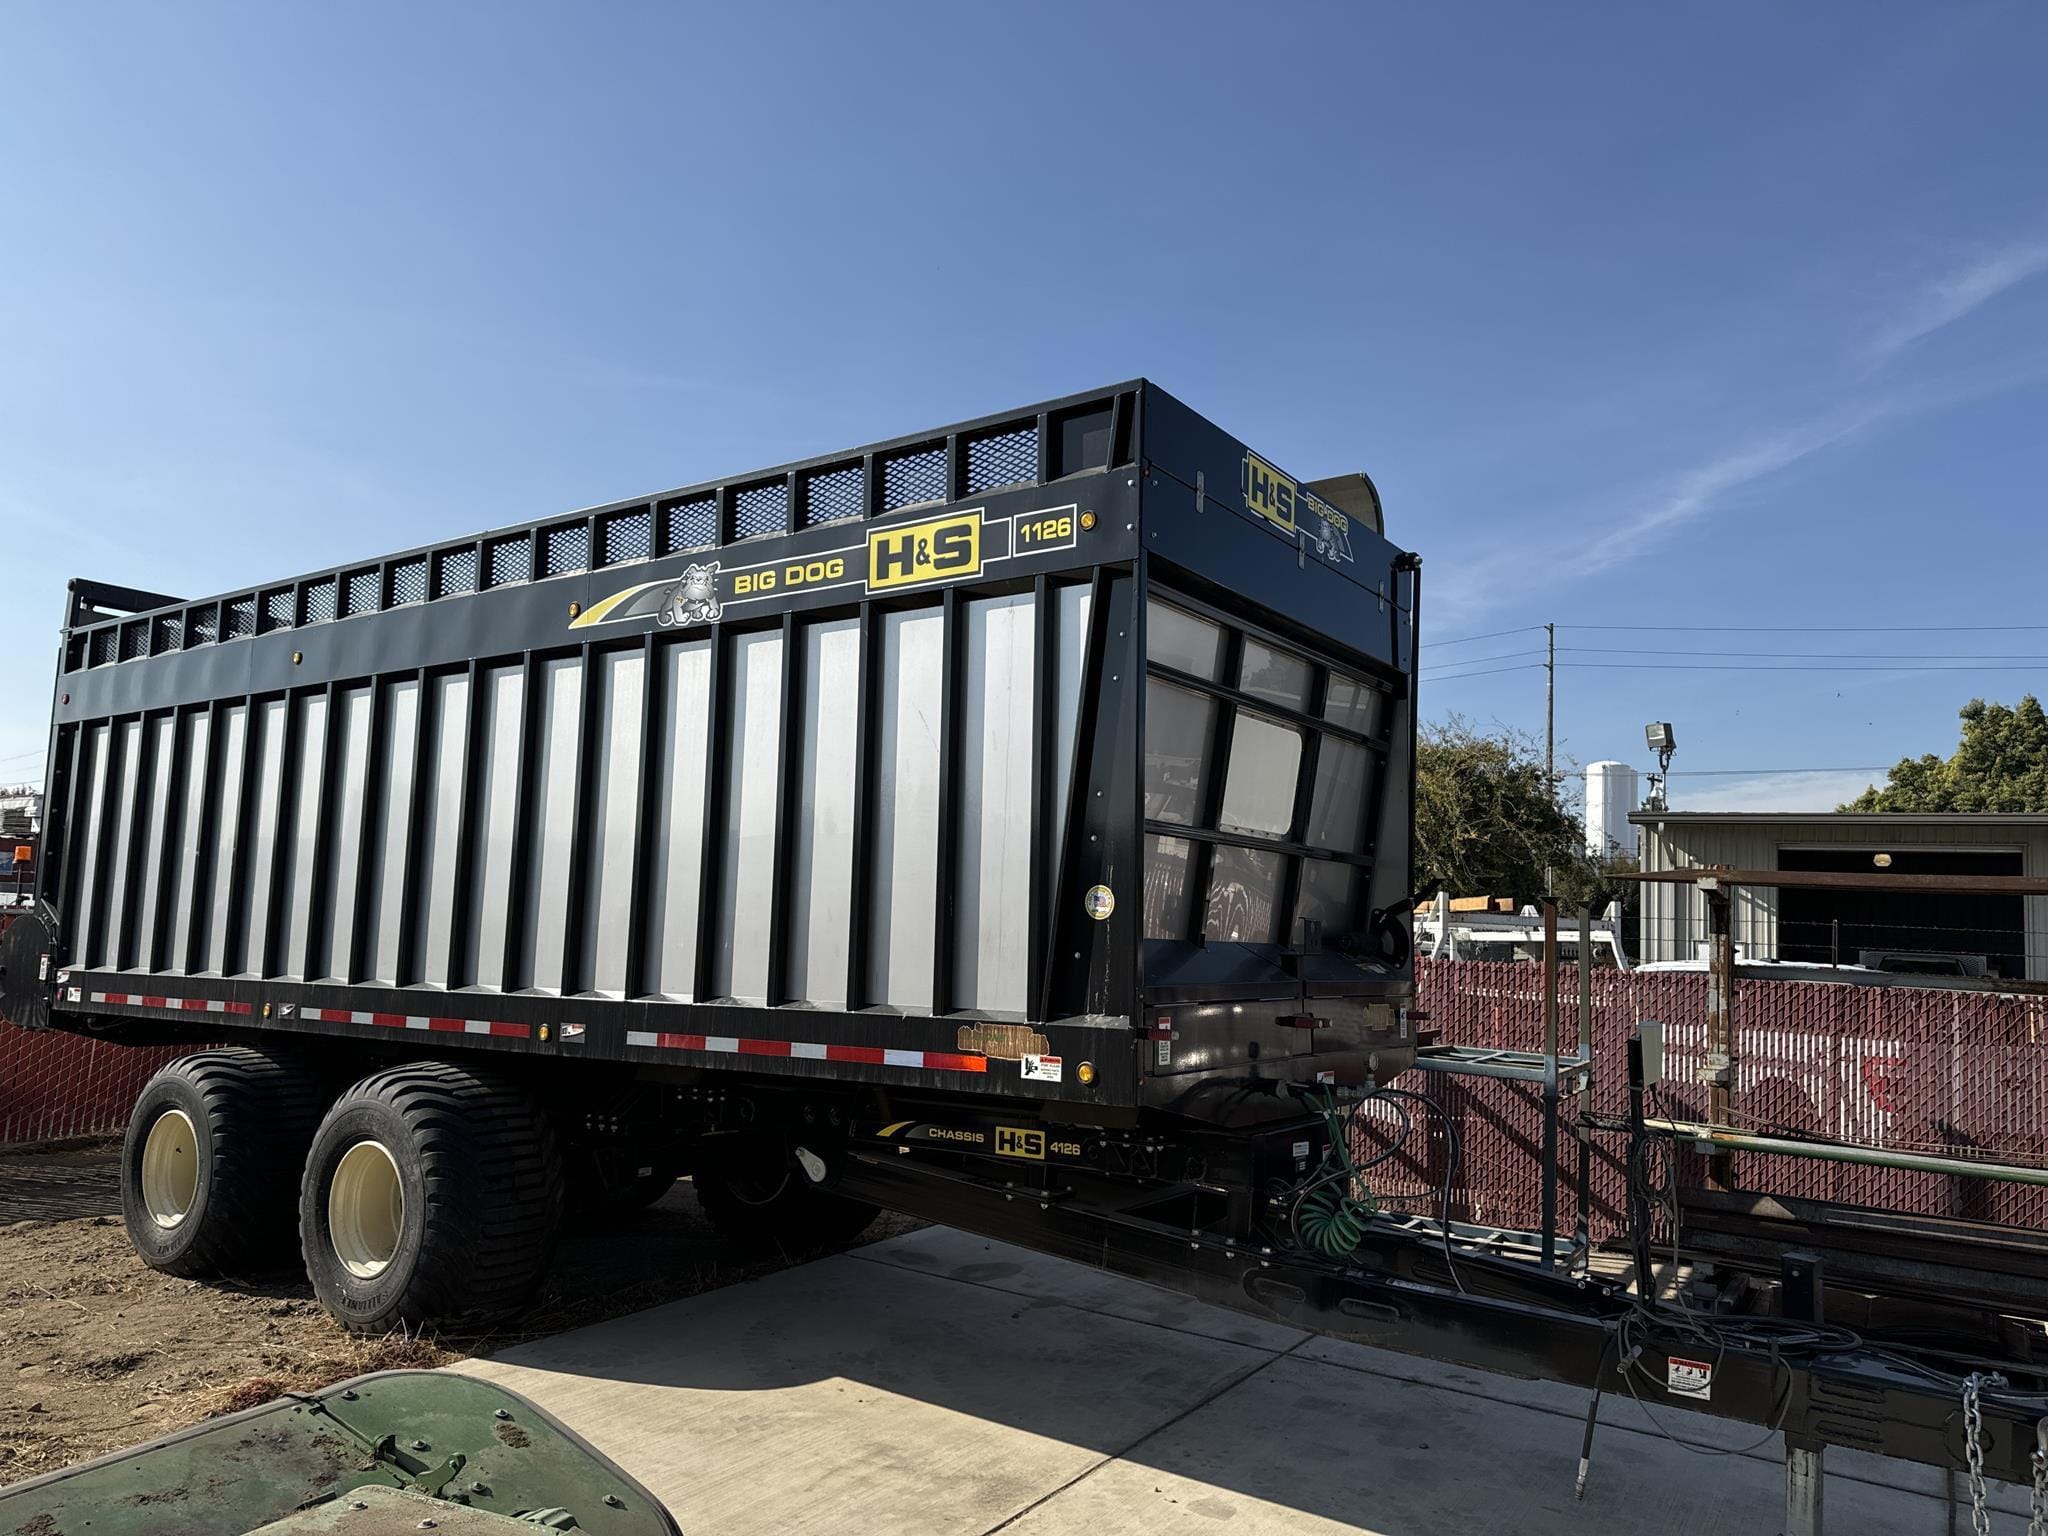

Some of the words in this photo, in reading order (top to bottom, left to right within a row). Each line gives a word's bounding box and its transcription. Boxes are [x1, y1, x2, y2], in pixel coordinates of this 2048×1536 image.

[1251, 464, 1292, 524] H&S
[734, 570, 776, 594] BIG
[785, 558, 844, 586] DOG
[876, 523, 973, 582] H&S
[1020, 516, 1072, 543] 1126
[928, 1127, 985, 1144] CHASSIS
[999, 1131, 1043, 1155] H&S
[1050, 1141, 1081, 1156] 4126
